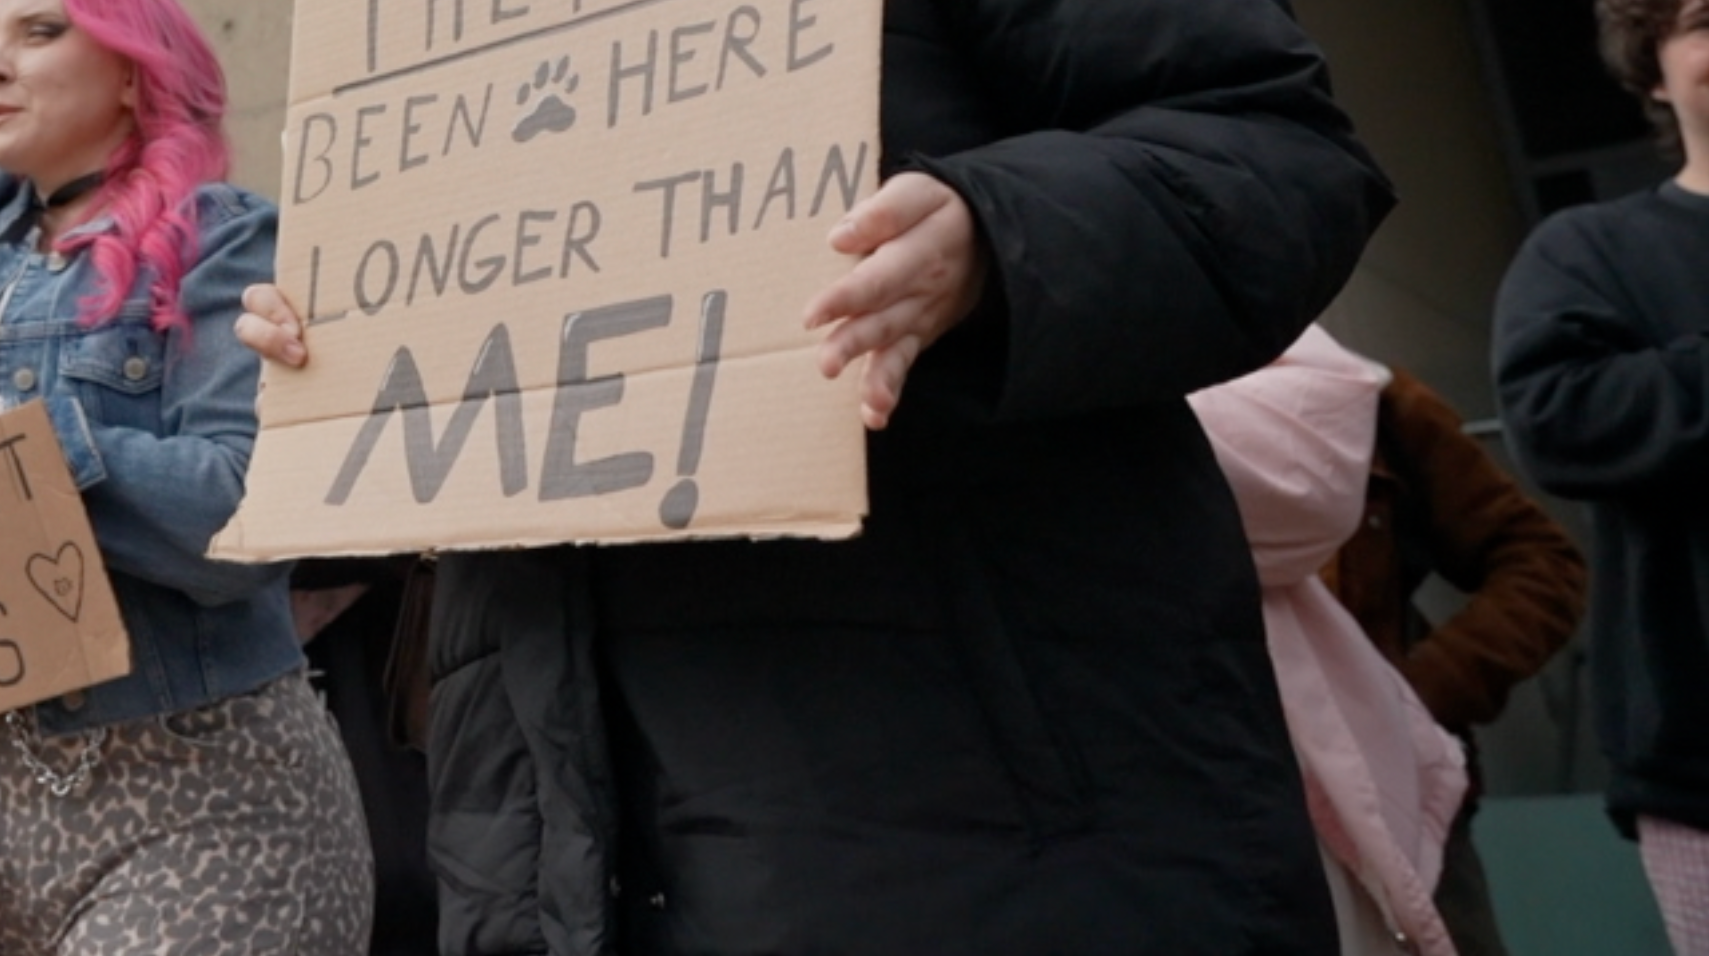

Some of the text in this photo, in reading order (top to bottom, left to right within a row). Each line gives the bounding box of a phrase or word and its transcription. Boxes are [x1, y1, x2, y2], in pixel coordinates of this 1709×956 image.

[291, 82, 494, 206] BEEN
[306, 141, 869, 328] LONGER THAN
[323, 288, 729, 531] ME!
